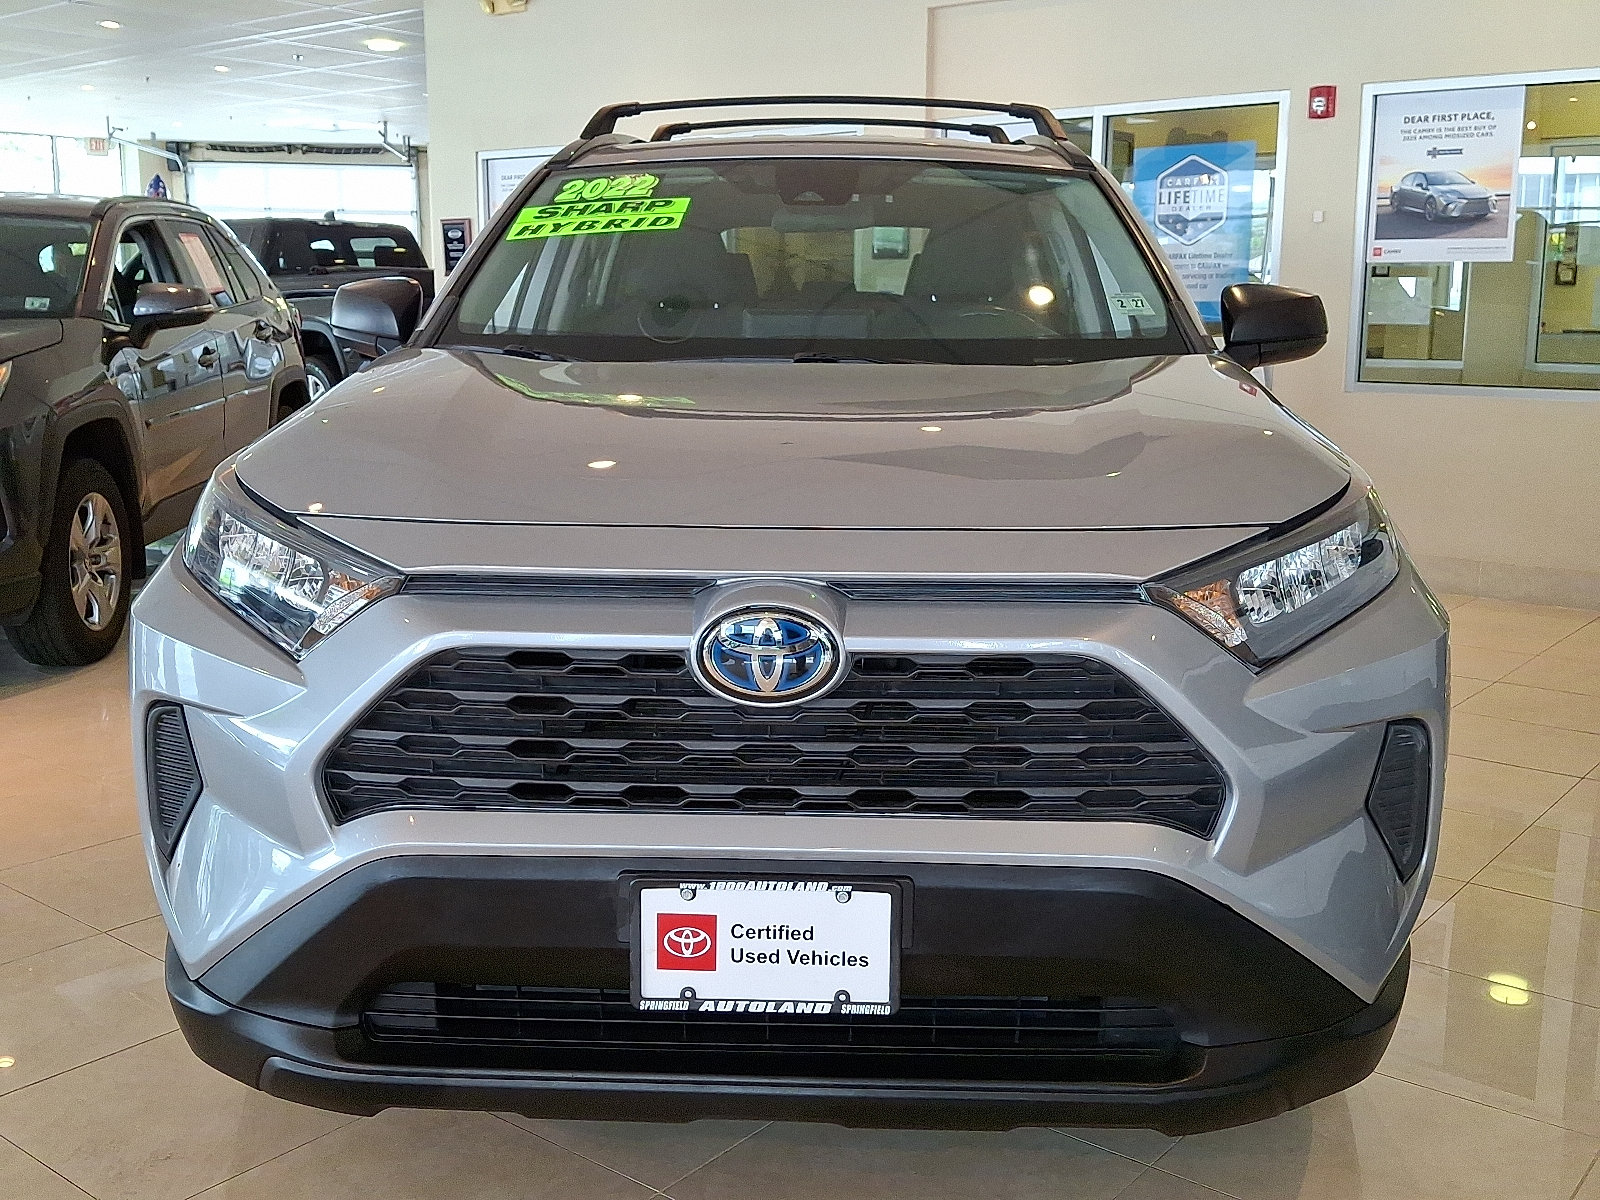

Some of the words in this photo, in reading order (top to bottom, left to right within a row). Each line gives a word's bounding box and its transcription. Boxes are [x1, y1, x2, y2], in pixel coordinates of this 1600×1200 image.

[1404, 115, 1429, 124] DEAR
[1432, 113, 1458, 123] FIRST
[1461, 111, 1495, 121] PLACE,
[553, 174, 660, 203] 2022
[1159, 188, 1225, 205] LIFETIME
[533, 200, 674, 220] SHARP
[513, 216, 677, 238] HYBRID
[1117, 299, 1127, 308] 2
[1132, 299, 1145, 308] 27
[730, 924, 815, 941] Certified
[730, 948, 781, 965] Used
[786, 950, 870, 968] Vehicles
[639, 1000, 690, 1011] SPRINGFIELD
[699, 1001, 833, 1014] AUTOLAND
[840, 1004, 891, 1016] SPRINGFIELD
